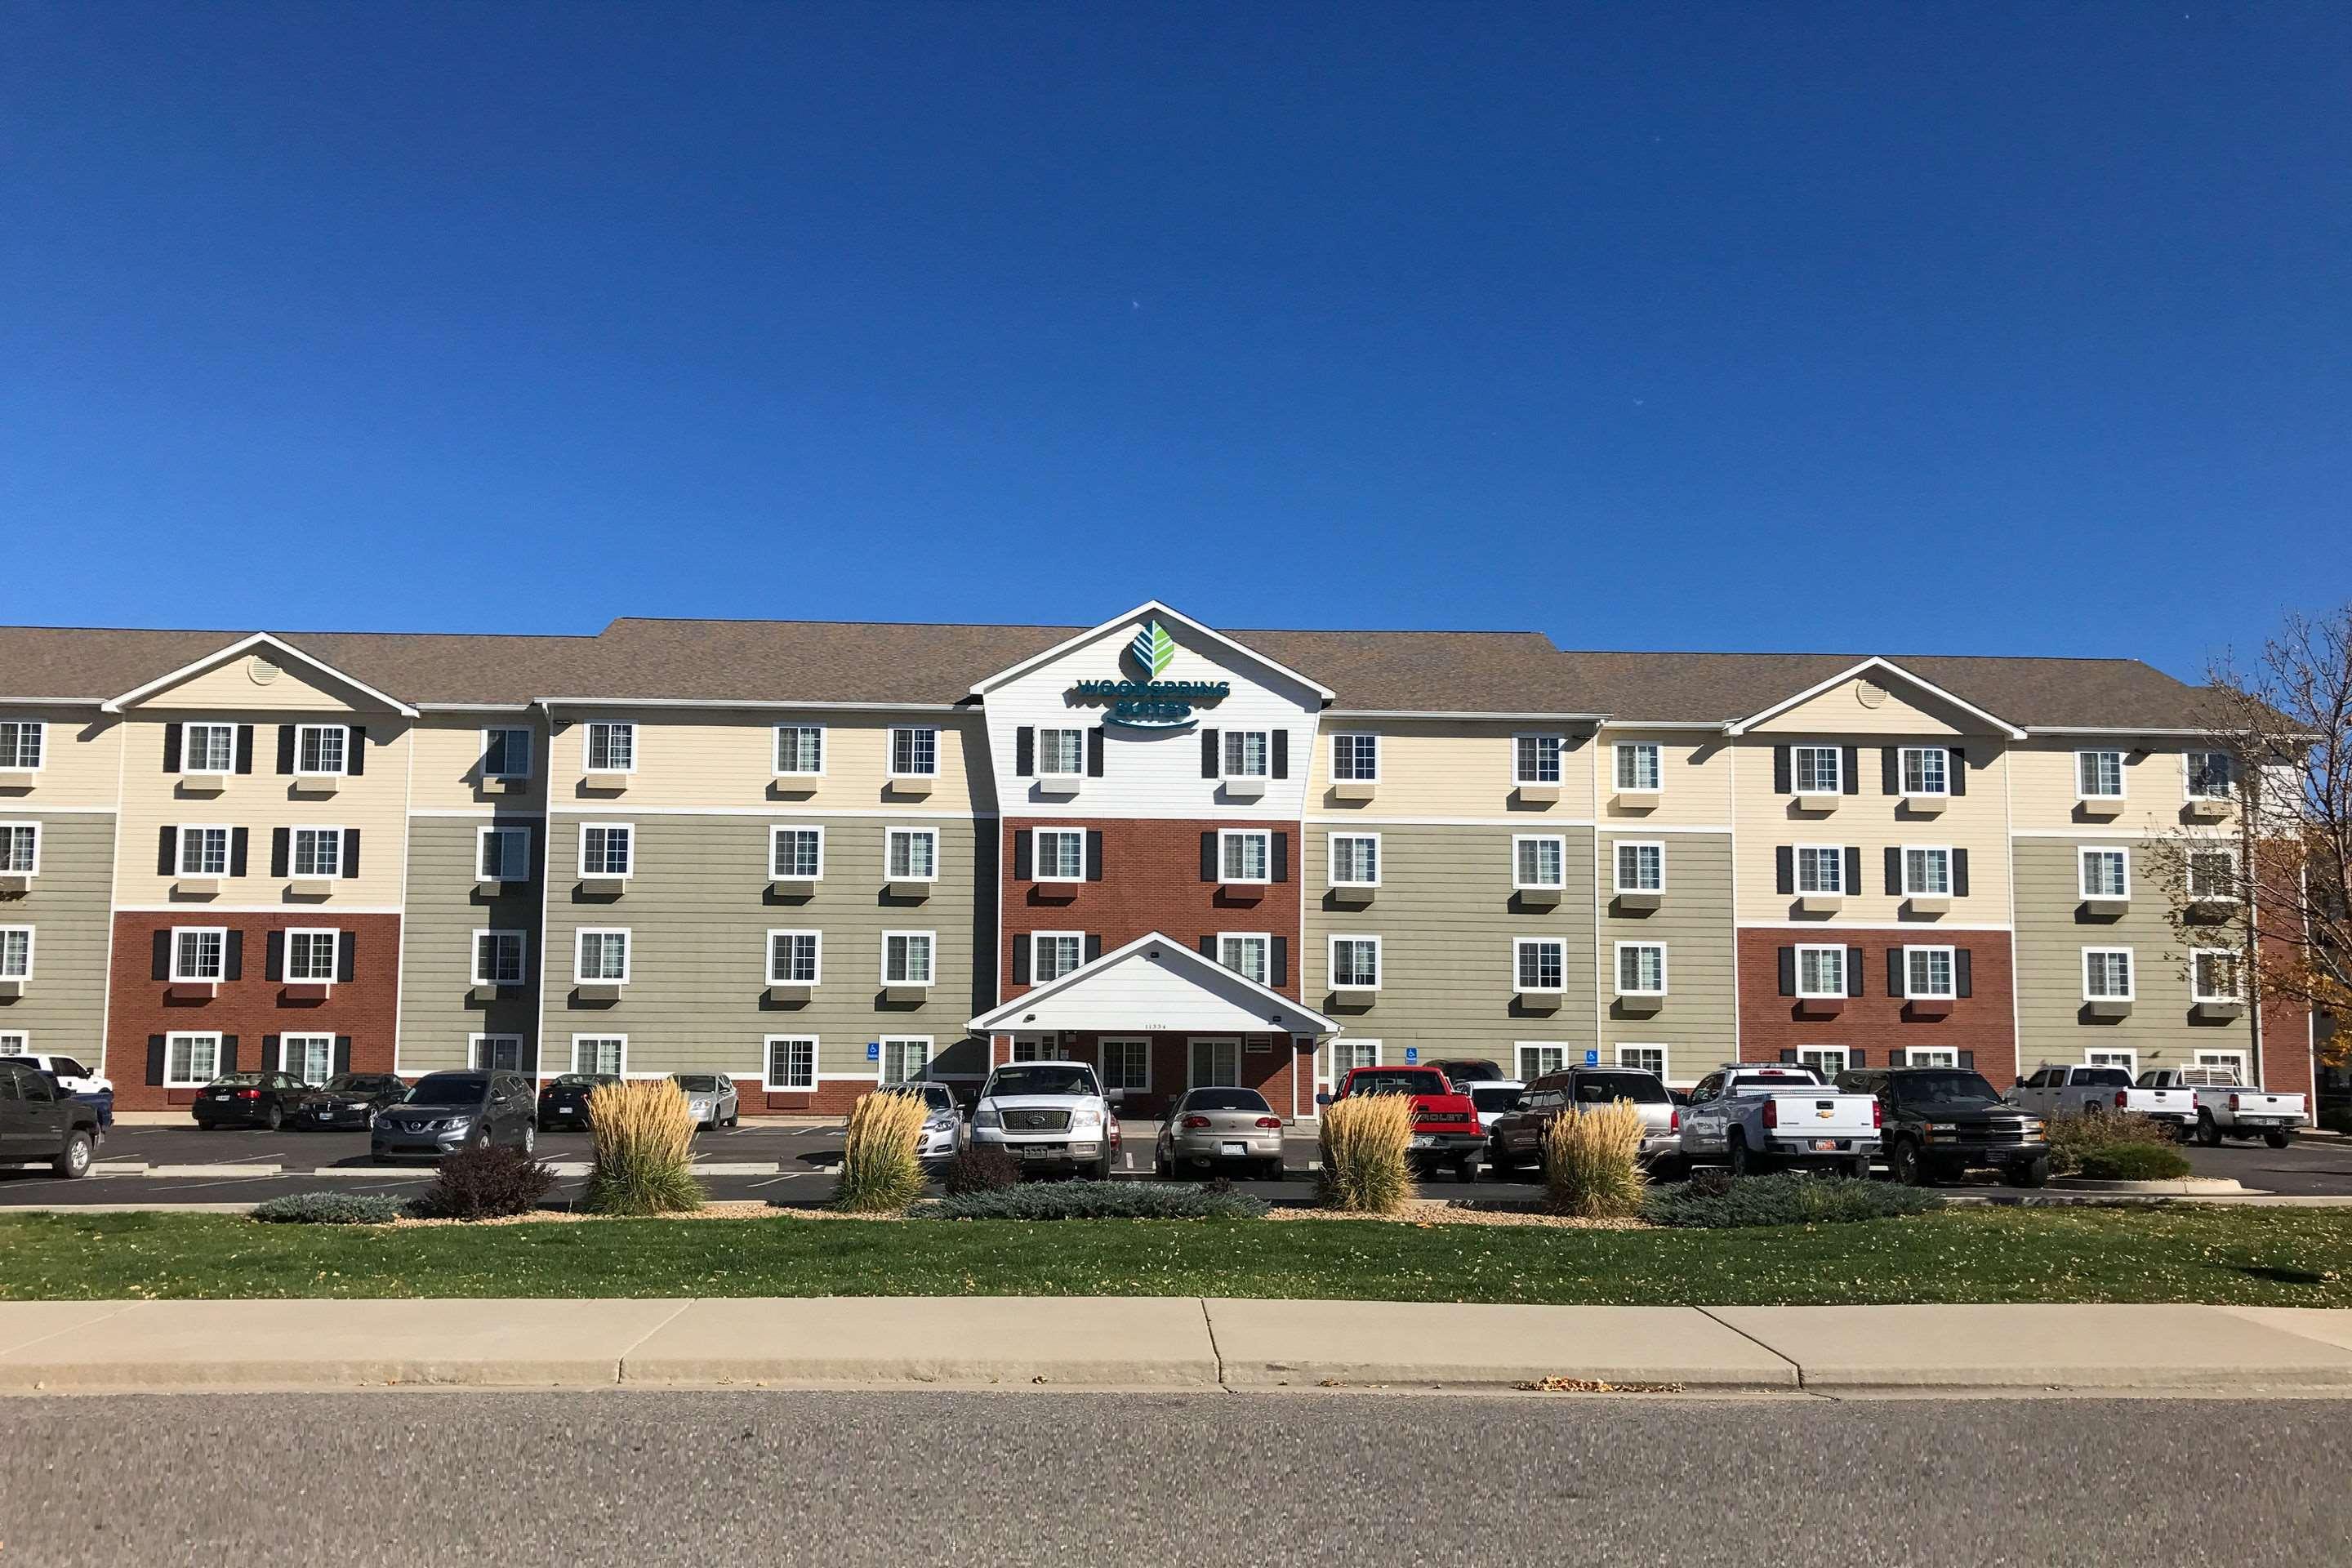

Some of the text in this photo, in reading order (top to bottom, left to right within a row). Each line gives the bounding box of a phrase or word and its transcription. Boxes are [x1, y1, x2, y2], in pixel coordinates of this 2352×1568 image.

[1076, 679, 1231, 697] WOODSPRING
[1116, 700, 1192, 716] SUITES
[1420, 1113, 1463, 1122] ROLET
